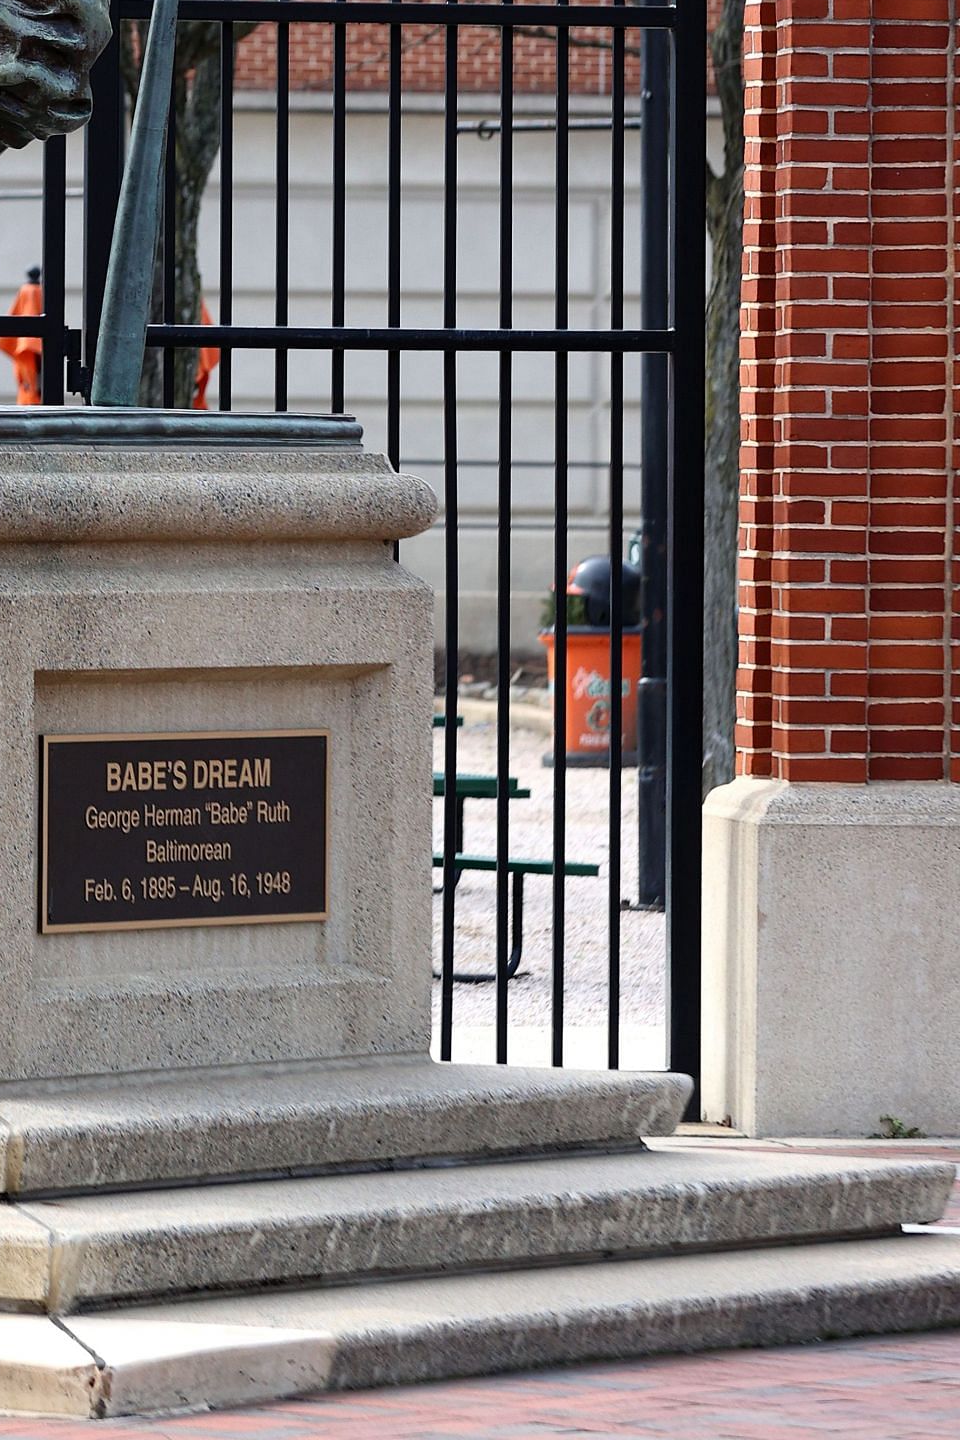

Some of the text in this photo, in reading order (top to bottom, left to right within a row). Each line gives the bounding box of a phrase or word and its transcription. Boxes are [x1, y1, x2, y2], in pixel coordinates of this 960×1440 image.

[106, 758, 271, 792] BABE’S DREAM
[85, 799, 291, 834] George Herman “Babe” Ruth
[146, 839, 232, 863] Baltimorean
[85, 878, 117, 902] Feb.
[121, 878, 135, 904] 6,
[140, 876, 176, 900] 1895
[191, 874, 225, 903] Aug.
[229, 872, 251, 898] 16,
[255, 871, 291, 895] 1948
